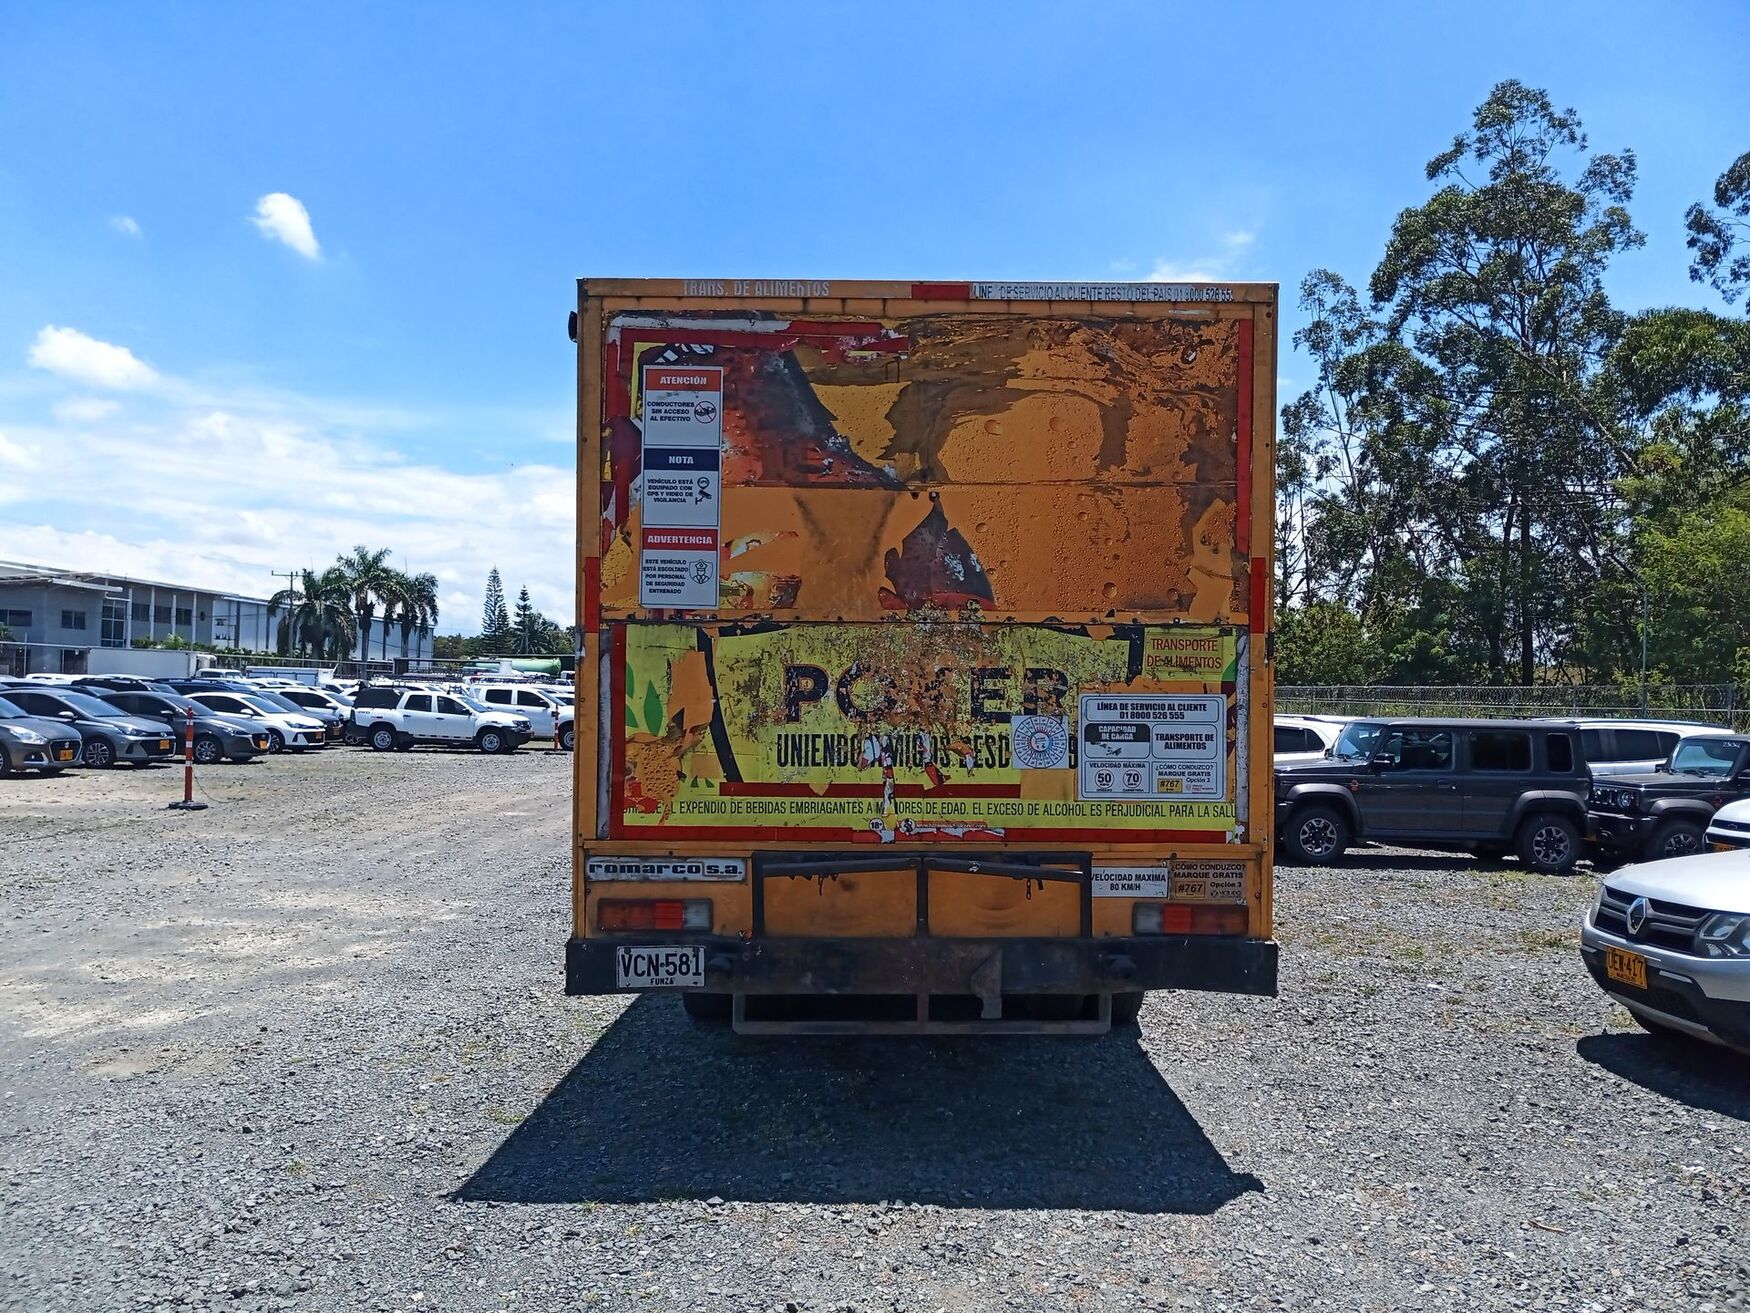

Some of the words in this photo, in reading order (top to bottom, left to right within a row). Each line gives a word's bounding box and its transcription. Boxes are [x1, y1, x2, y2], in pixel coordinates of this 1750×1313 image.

[734, 280, 750, 296] DE
[755, 280, 830, 297] ALIMENTOS
[1068, 286, 1103, 300] CLIENTE
[1105, 286, 1134, 300] RESTO
[660, 376, 707, 385] ATENCIÓN
[668, 456, 694, 464] NOTA
[648, 536, 712, 544] ADVERTENCIA
[1151, 638, 1218, 652] TRANSPORTE
[1147, 654, 1160, 667] DE
[1161, 656, 1222, 668] ALIMENTOS
[1097, 702, 1118, 711] LÍNEA
[1120, 703, 1129, 711] DE
[1131, 703, 1165, 711] SERVICIO
[1166, 703, 1176, 711] AL
[1178, 703, 1207, 712] CLIENTE
[1153, 712, 1167, 720] 526
[1169, 712, 1184, 720] 555
[1155, 733, 1203, 742] TRANSPORTE
[1205, 734, 1214, 742] DE
[1164, 742, 1206, 750] ALIMENTOS
[959, 734, 1010, 769] DESD
[1097, 773, 1111, 783] 50
[1126, 773, 1139, 783] 70
[1160, 780, 1180, 788] #767
[680, 801, 726, 814] EXPENDIO
[731, 801, 743, 814] DE
[747, 801, 786, 814] BEBIDAS
[790, 801, 863, 814] EMBRIAGANTES
[867, 802, 872, 814] A
[926, 802, 937, 815] DE
[942, 802, 969, 815] EDAD.
[973, 803, 983, 815] EL
[988, 803, 1024, 815] EXCESO
[1028, 803, 1039, 816] DE
[1043, 803, 1086, 816] ALCOHOL
[1090, 804, 1101, 817] ES
[1106, 804, 1165, 817] PERJUDICIAL
[1169, 805, 1194, 817] PARA
[1198, 805, 1209, 817] LA
[1212, 805, 1236, 818] SALU
[589, 864, 700, 874] romarco
[706, 864, 743, 874] s.a.
[1091, 873, 1133, 882] VELOCIDAD
[1135, 873, 1166, 882] MAXIMA
[1110, 883, 1119, 891] 80
[1121, 883, 1141, 891] KM/H
[1178, 884, 1203, 893] #767
